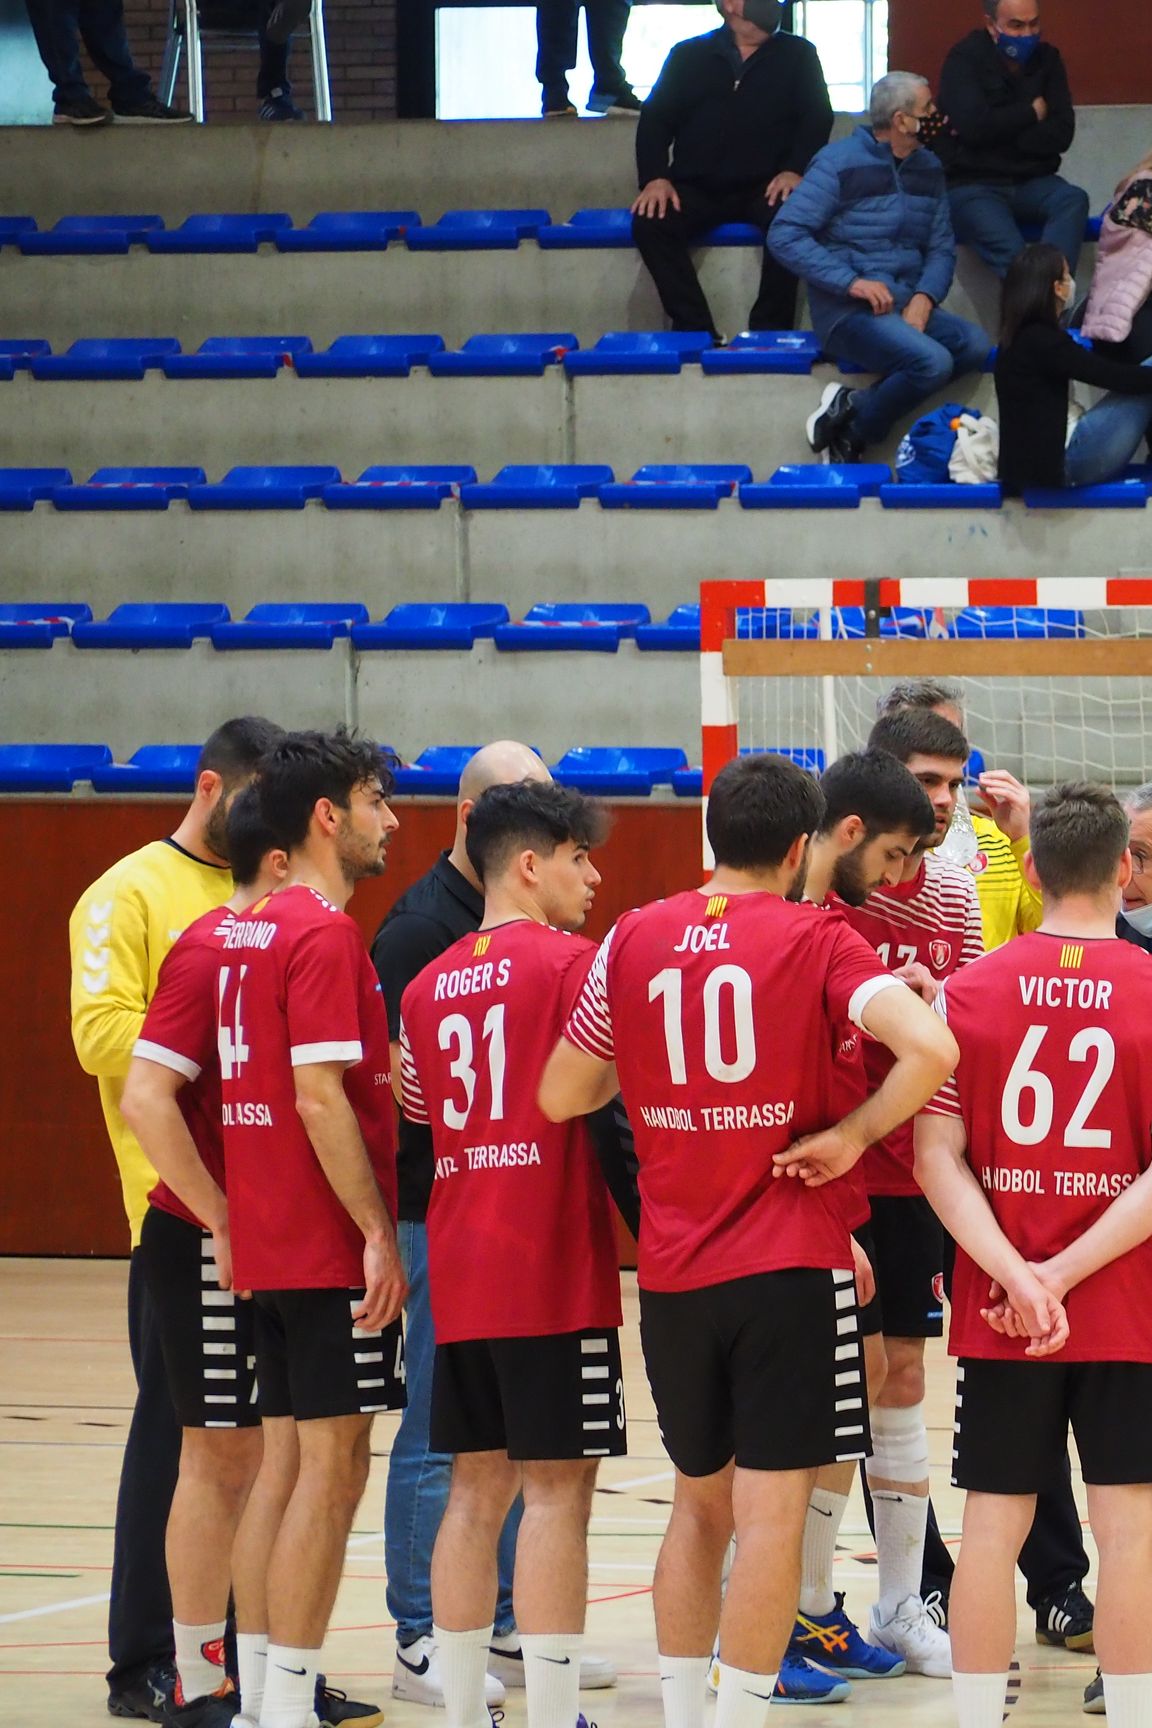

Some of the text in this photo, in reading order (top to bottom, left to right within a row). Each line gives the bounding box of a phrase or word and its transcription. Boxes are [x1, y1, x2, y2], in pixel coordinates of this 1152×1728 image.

[673, 923, 731, 954] JOEL
[434, 958, 512, 1002] ROGER S
[1018, 975, 1114, 1010] VICTOR
[648, 963, 757, 1085] 10
[437, 1003, 507, 1131] 31
[1001, 1024, 1117, 1149] 62
[639, 1100, 795, 1132] HANDBOL TERRASSA
[463, 1142, 541, 1171] TERRASSA
[1053, 1171, 1140, 1197] TERRASS
